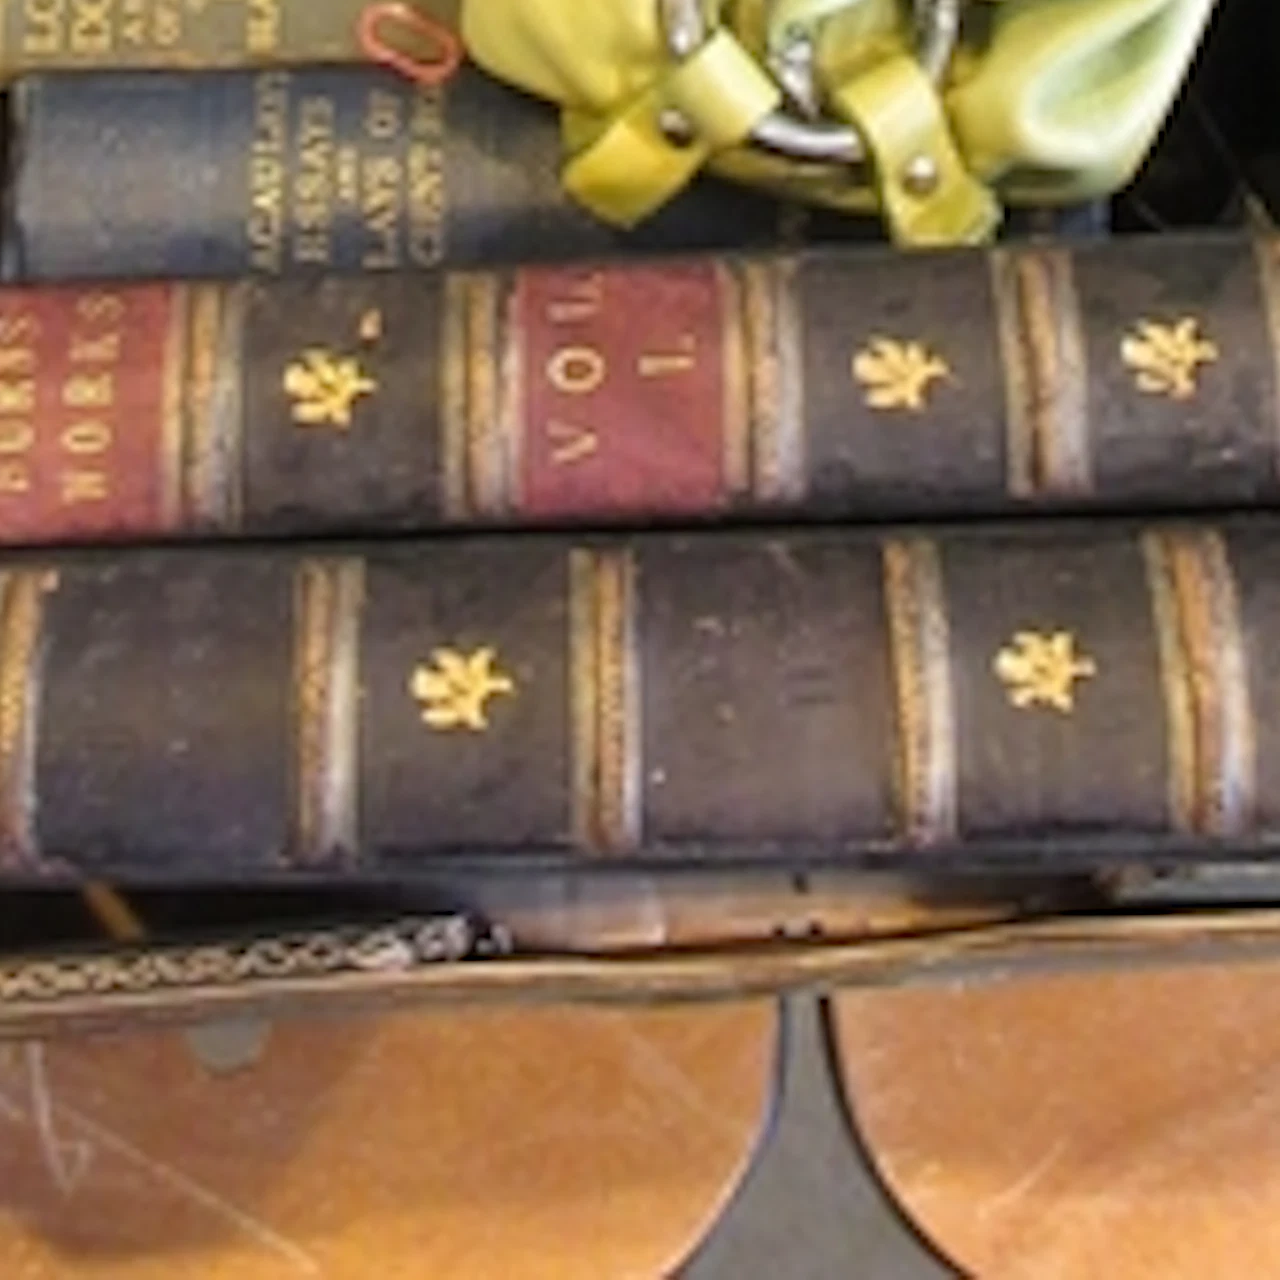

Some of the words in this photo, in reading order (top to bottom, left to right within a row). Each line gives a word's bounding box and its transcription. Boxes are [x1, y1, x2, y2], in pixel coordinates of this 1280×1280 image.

[293, 95, 334, 264] ESSAYS
[362, 156, 402, 269] LAYS
[58, 292, 125, 506] WORKS
